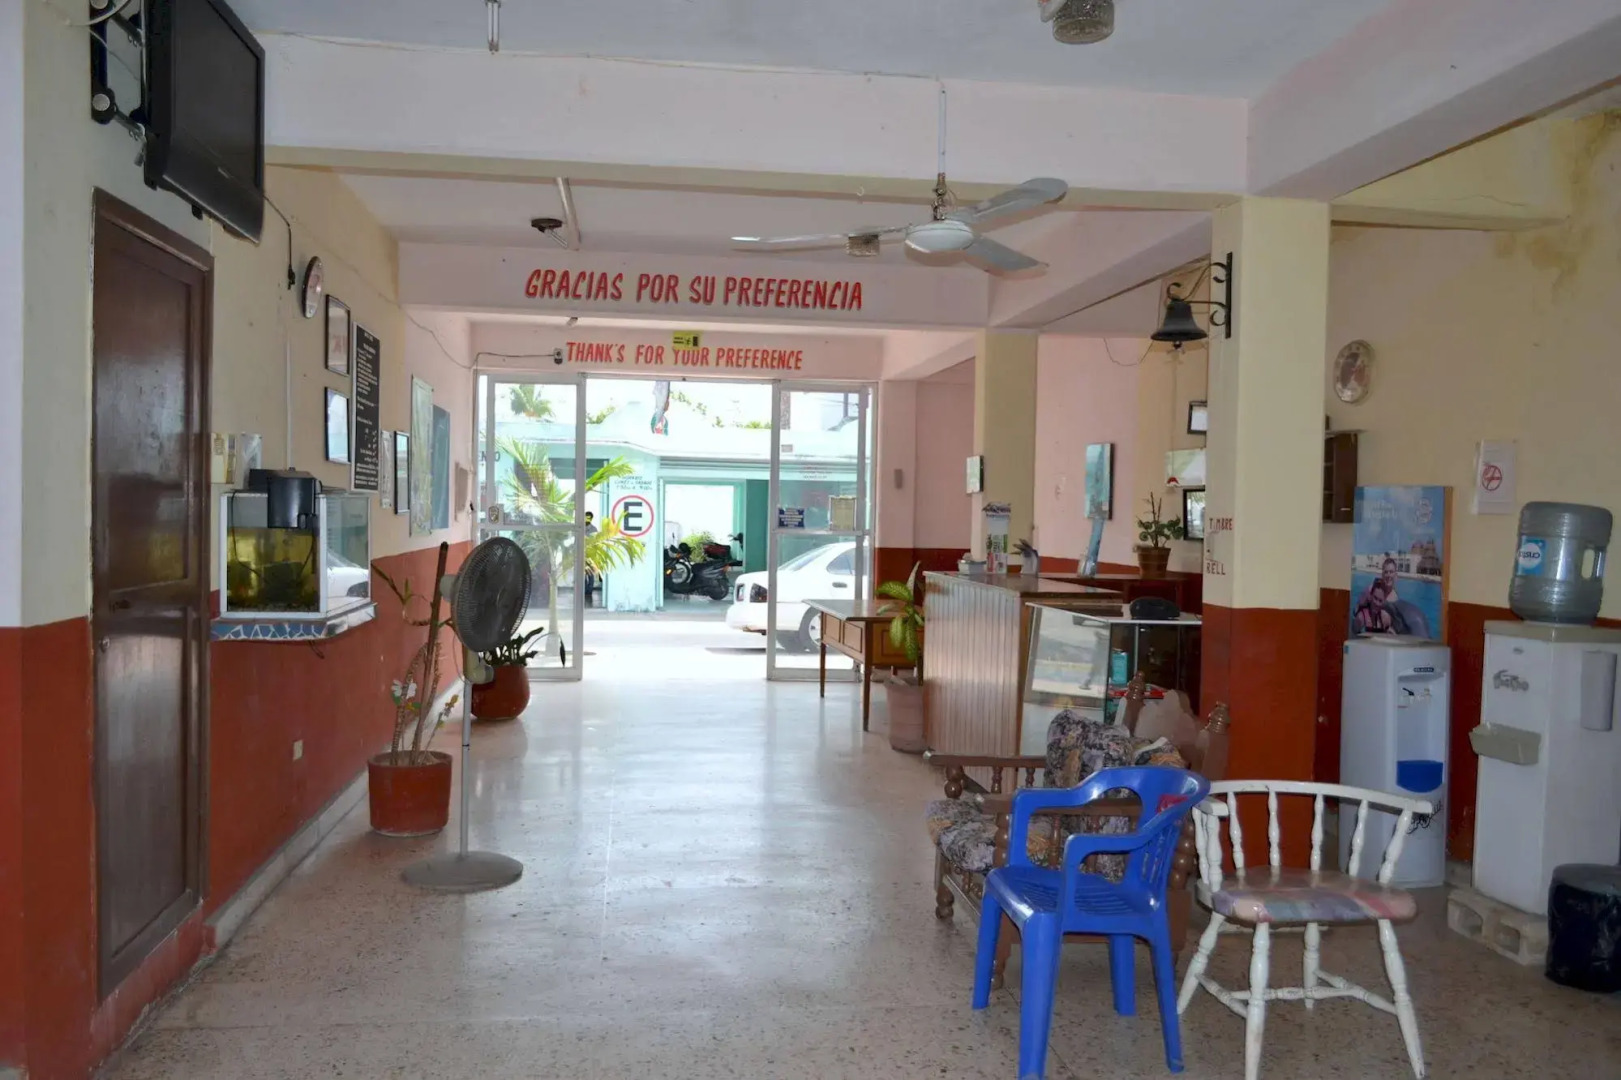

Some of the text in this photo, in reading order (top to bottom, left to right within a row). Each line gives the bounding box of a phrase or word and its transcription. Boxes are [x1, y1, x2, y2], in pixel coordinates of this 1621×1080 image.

[525, 268, 863, 311] GRACIAS POR SU PREFERENCIA
[566, 342, 803, 371] THANK'S FOR YOUR PREFERENCE
[623, 501, 643, 531] E
[1209, 517, 1233, 531] TIMBRE
[1206, 561, 1226, 576] BELL
